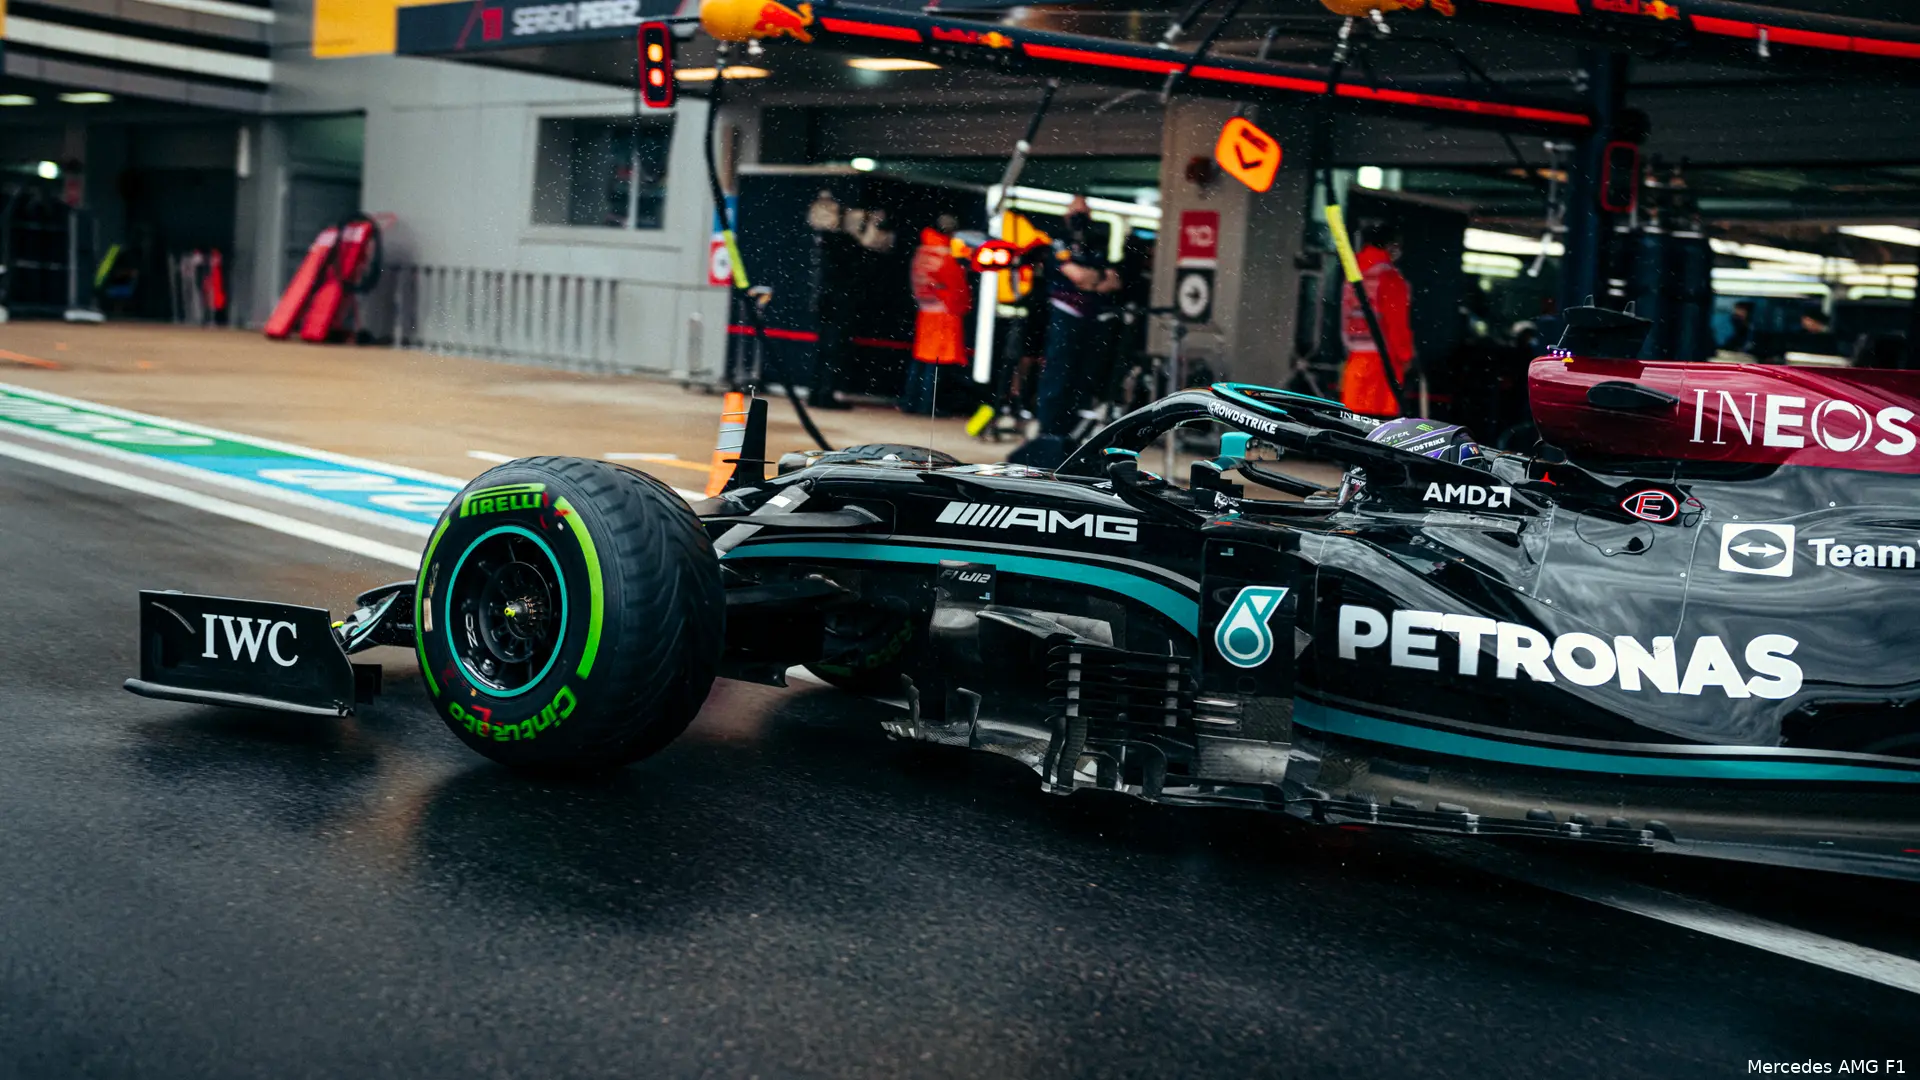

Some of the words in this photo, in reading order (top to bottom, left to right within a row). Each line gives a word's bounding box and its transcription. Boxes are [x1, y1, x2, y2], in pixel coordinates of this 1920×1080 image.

[1207, 399, 1278, 435] CROWDSTRIKE
[1339, 410, 1381, 427] INEOS
[1690, 388, 1917, 456] INEOS
[459, 483, 546, 518] PIRELLI
[1423, 482, 1487, 505] AMD
[998, 506, 1139, 542] AMG
[1808, 538, 1920, 568] Team
[958, 571, 991, 584] W12
[202, 613, 299, 667] IWC
[1338, 604, 1804, 699] PETRONAS
